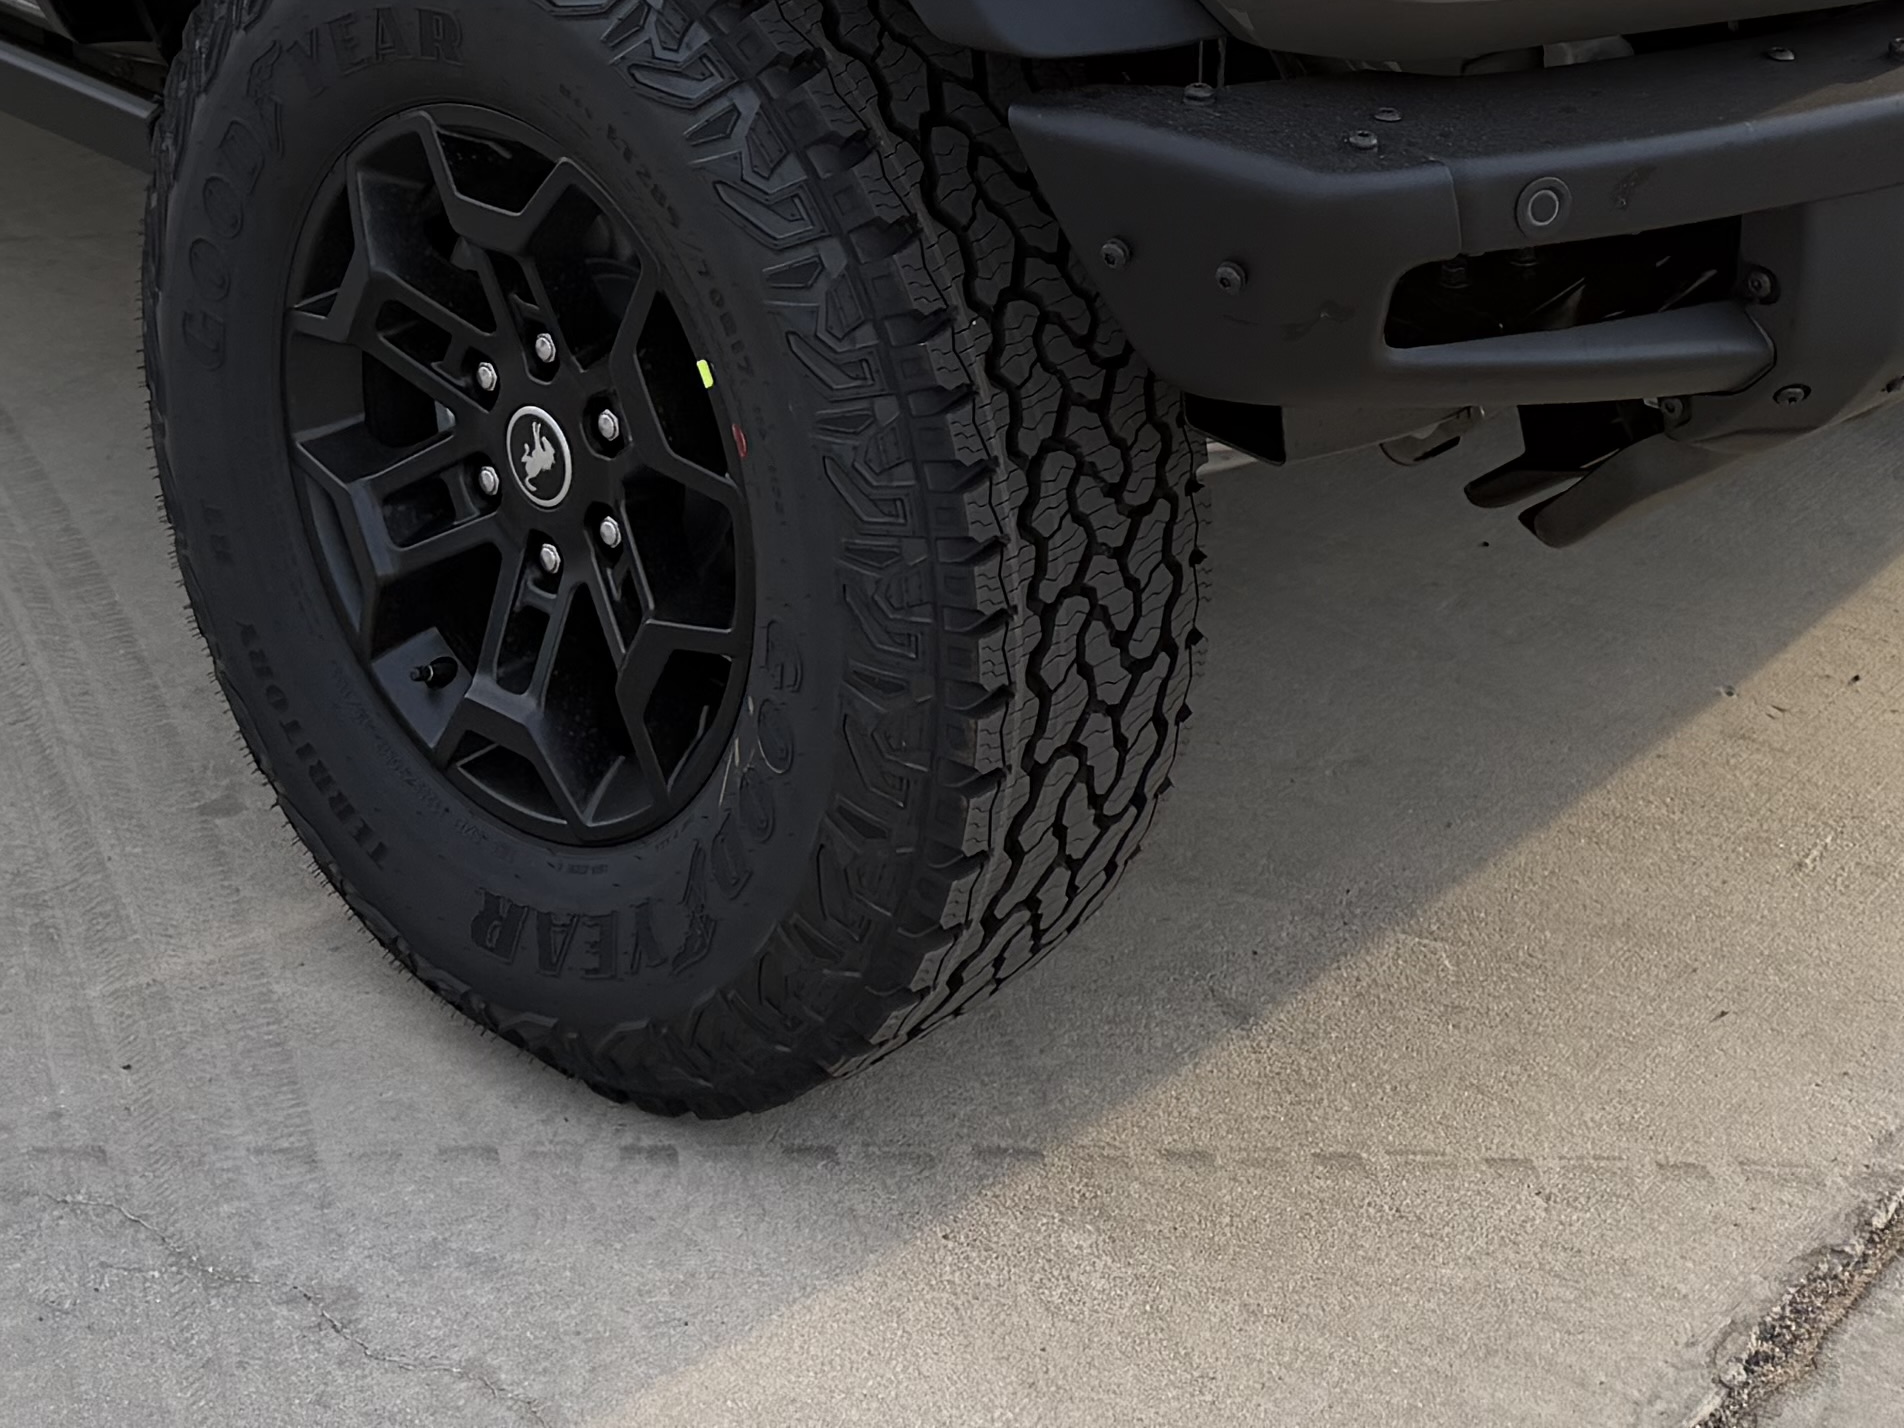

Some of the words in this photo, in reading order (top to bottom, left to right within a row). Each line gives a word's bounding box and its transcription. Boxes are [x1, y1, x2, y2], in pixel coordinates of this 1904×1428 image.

[182, 3, 465, 372] GOODYEAR
[235, 620, 389, 871] TERRITORY
[469, 617, 804, 983] GOODYEAR
